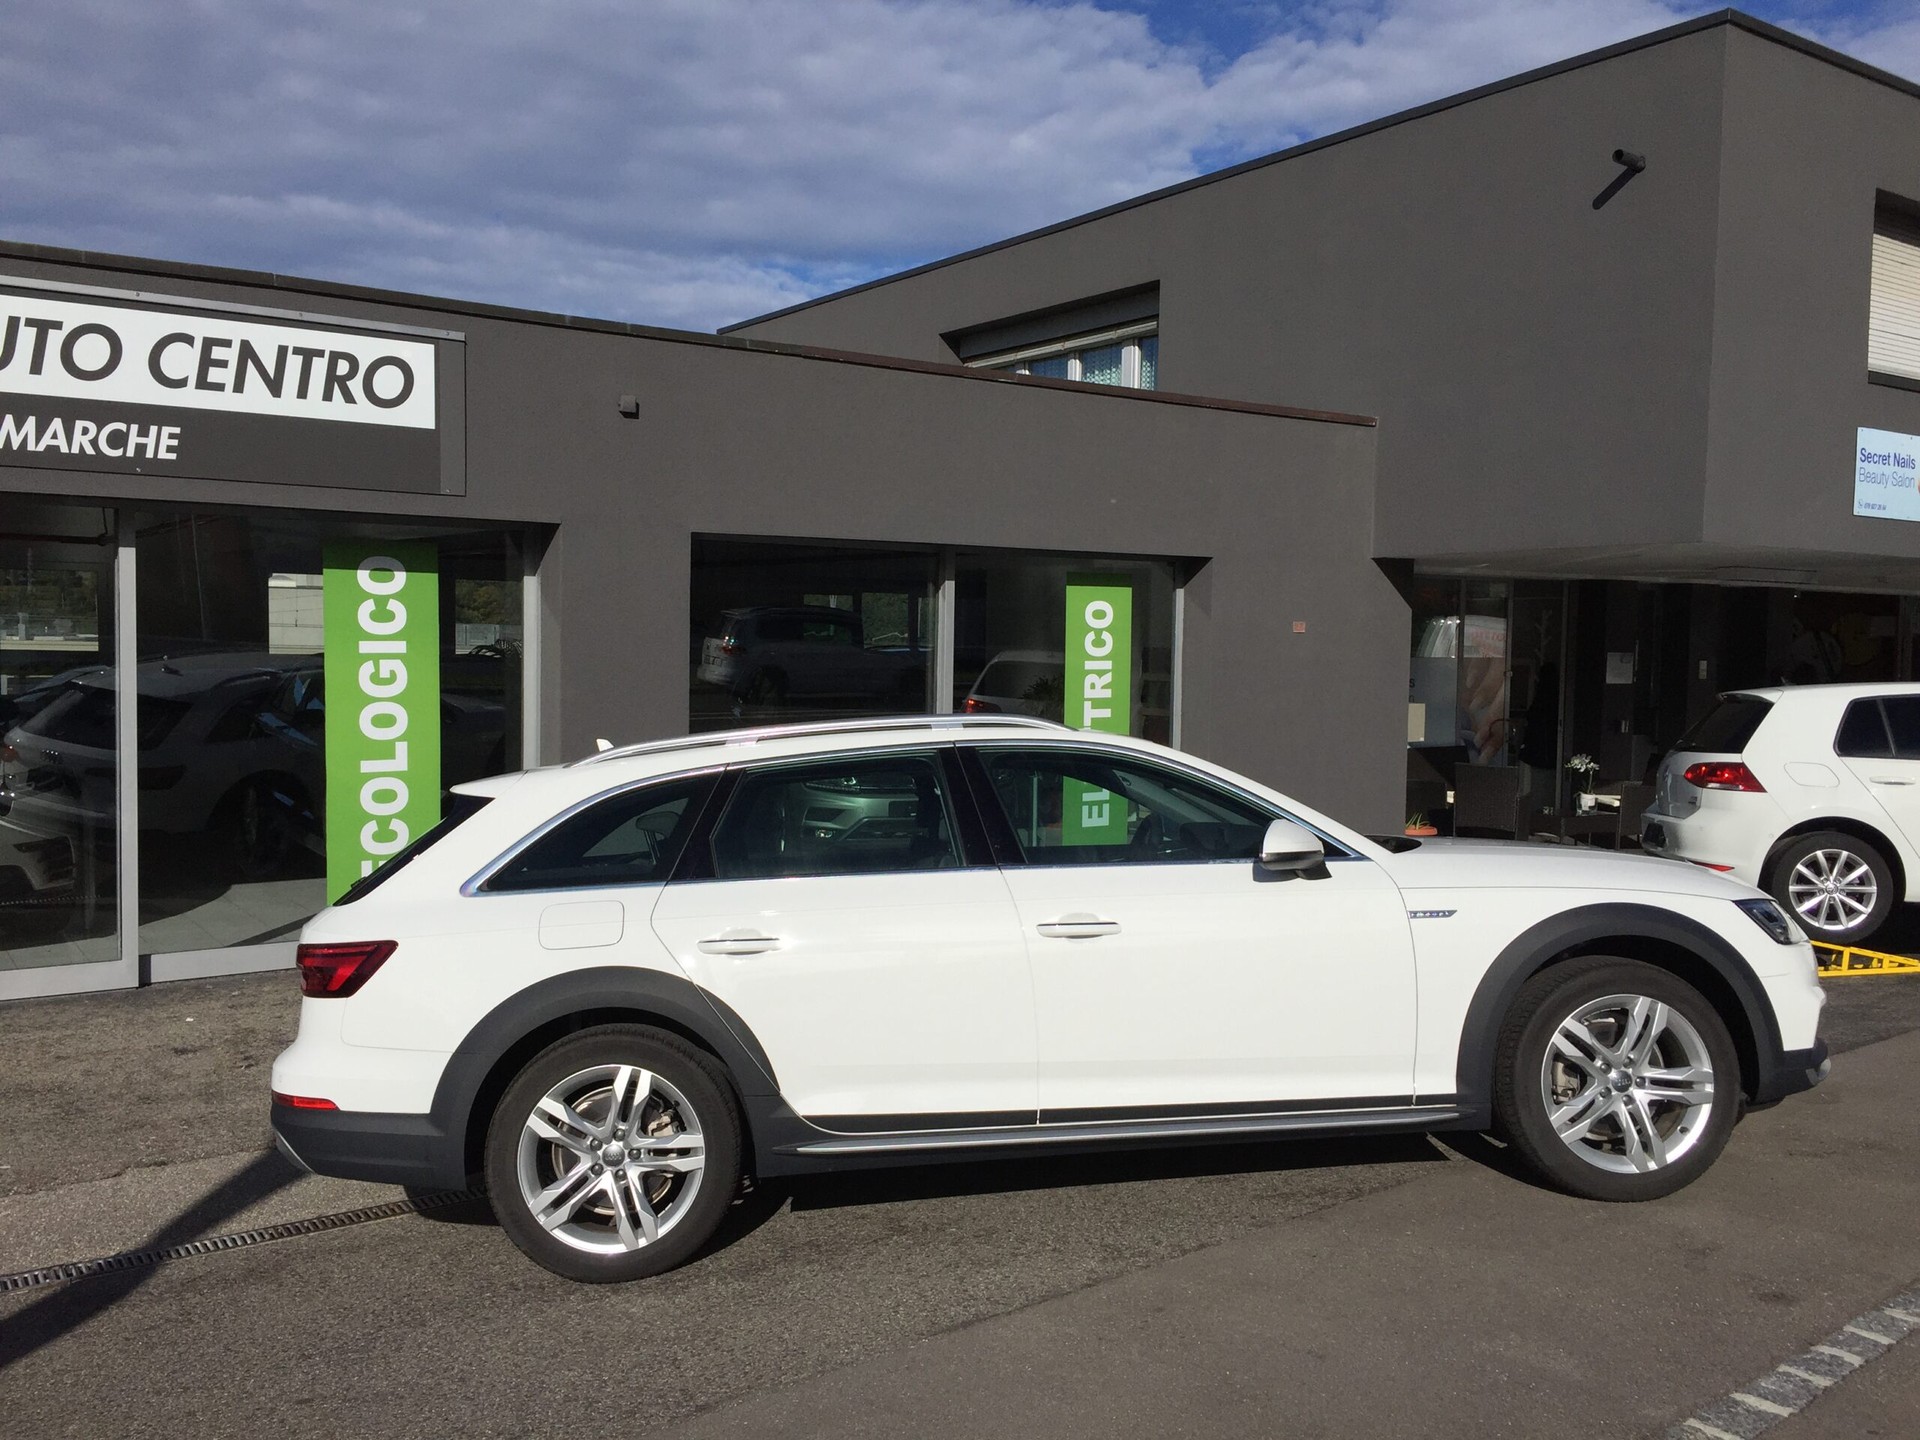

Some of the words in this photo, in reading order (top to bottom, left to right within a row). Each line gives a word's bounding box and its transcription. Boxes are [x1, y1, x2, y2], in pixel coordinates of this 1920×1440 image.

[148, 332, 415, 409] CENTRO
[0, 413, 181, 460] MARCHE
[1860, 447, 1891, 466] Secret
[1893, 452, 1916, 470] Nails
[1858, 467, 1890, 489] Beauty
[1891, 471, 1915, 489] Salon
